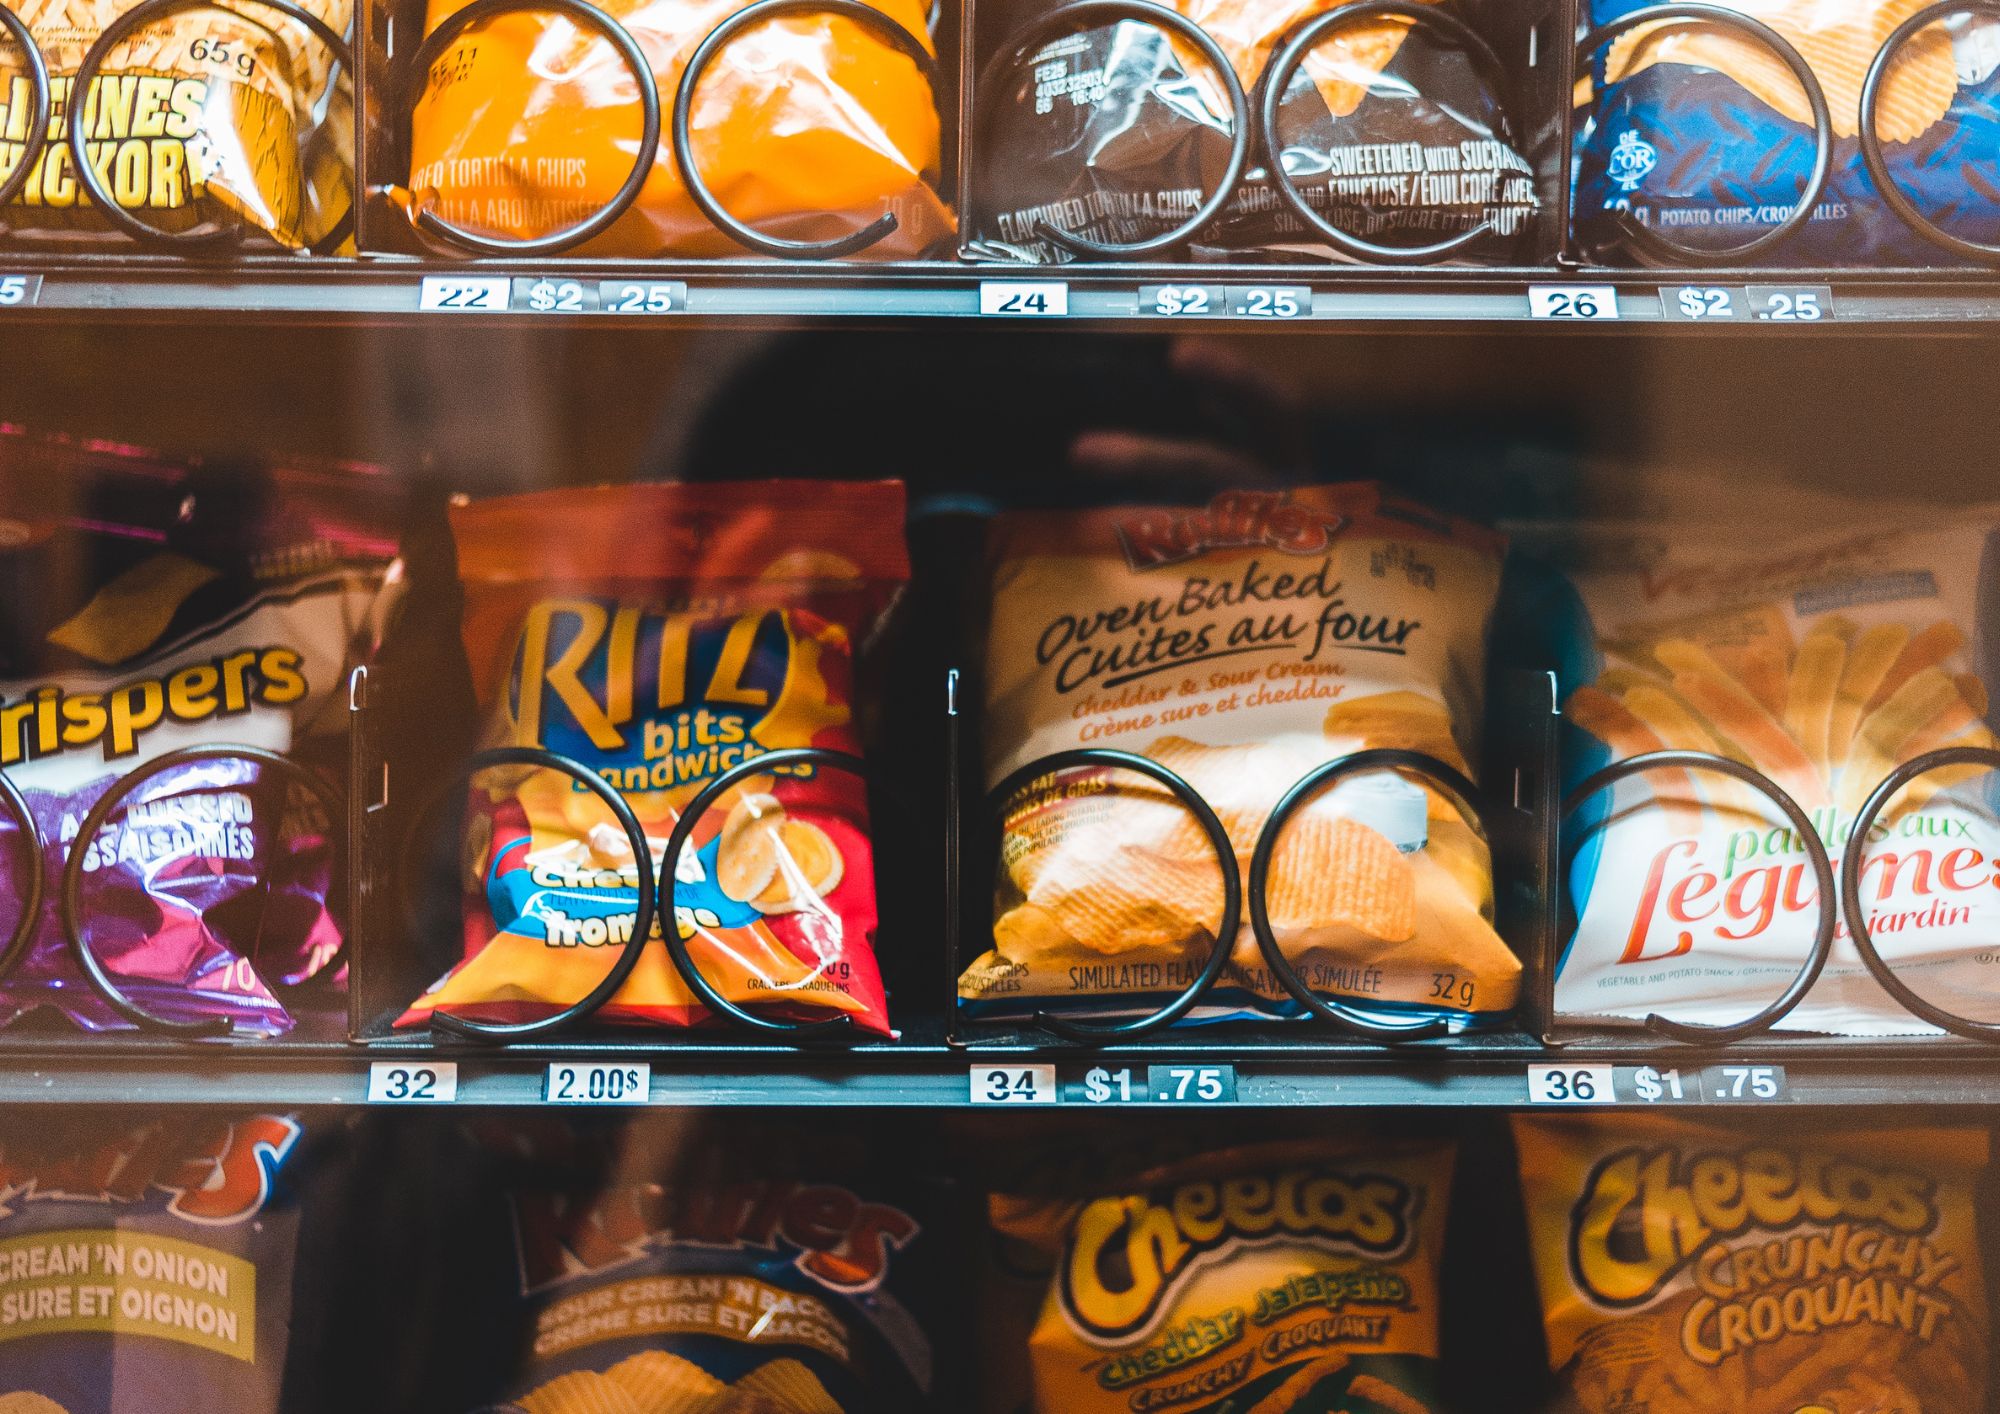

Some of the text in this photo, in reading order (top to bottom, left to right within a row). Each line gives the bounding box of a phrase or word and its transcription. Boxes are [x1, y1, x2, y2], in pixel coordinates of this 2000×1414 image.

[0, 75, 208, 140] IENNES
[536, 157, 587, 189] CHIPS
[1328, 141, 1424, 177] SWEETENED
[1423, 146, 1461, 171] WITH
[1157, 188, 1203, 220] CHIPS
[1660, 207, 1712, 227] POTATO
[1714, 202, 1848, 227] CHIPS/CROILLES
[437, 281, 491, 307] 22
[528, 279, 672, 313] $2 .25
[998, 291, 1049, 314] 24
[1155, 285, 1299, 316] $2 .25
[1547, 292, 1599, 318] 26
[1678, 286, 1822, 320] $2 .25
[1035, 597, 1172, 668] Oven
[1176, 556, 1347, 616] Baked
[1055, 599, 1422, 695] Cuites au four
[514, 599, 769, 752] RITZ
[1207, 667, 1262, 692] Sour
[1265, 659, 1347, 682] Cream
[1078, 677, 1346, 743] Crème sure et cheddar
[643, 708, 745, 761] bits
[573, 742, 814, 791] andwichs
[1899, 812, 1979, 844] aux
[63, 822, 255, 872] SSAISONNÉS
[1068, 962, 1162, 991] SIMULATED
[1311, 961, 1383, 994] SIMULÉE
[1428, 973, 1455, 1000] 32
[1597, 975, 1646, 989] VEGETABLE
[1649, 973, 1667, 984] AND
[1668, 967, 1702, 980] POTATO
[384, 1069, 437, 1099] 32
[557, 1068, 639, 1100] 2.00$
[984, 1069, 1038, 1101] 34
[1083, 1066, 1223, 1103] $1 .75
[1544, 1070, 1596, 1100] 36
[1634, 1066, 1778, 1102] $1 .75
[1578, 1149, 1932, 1300] Cheetos
[1068, 1174, 1400, 1331] Cheetos
[1694, 1223, 1959, 1298] CRUNCHY
[0, 1244, 90, 1283] CREAM
[131, 1247, 230, 1299] ONION
[619, 1278, 722, 1304] CREAM
[2, 1286, 238, 1344] SURE ET OIGNON
[634, 1302, 712, 1328] SURE
[716, 1306, 749, 1331] ET
[1682, 1277, 1951, 1366] CROQUANT
[1129, 1315, 1390, 1412] CRUNCHY CROQUANT
